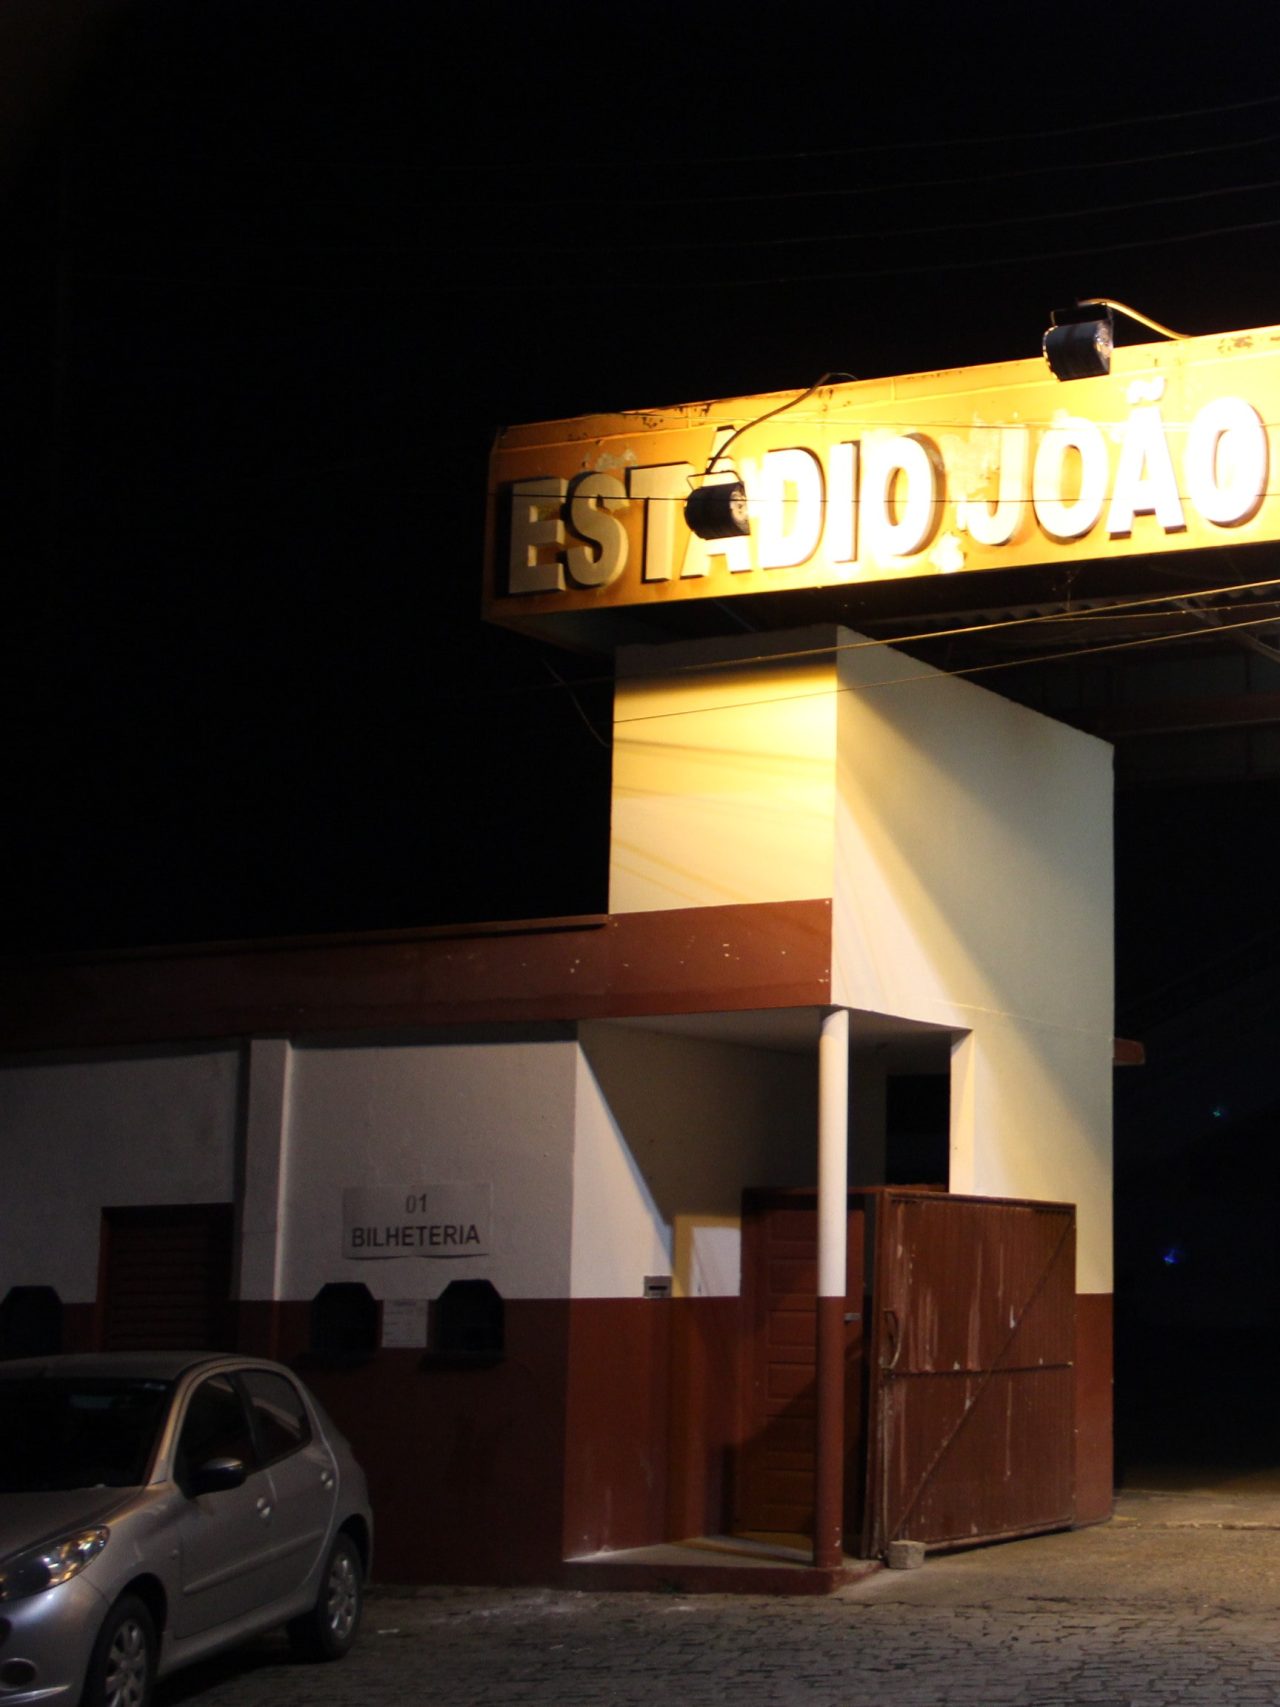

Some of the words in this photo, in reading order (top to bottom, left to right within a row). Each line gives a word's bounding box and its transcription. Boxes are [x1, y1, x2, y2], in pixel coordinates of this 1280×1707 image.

[956, 376, 1268, 548] JOÃO
[405, 1193, 428, 1214] 01
[351, 1224, 481, 1248] BILHETERIA
